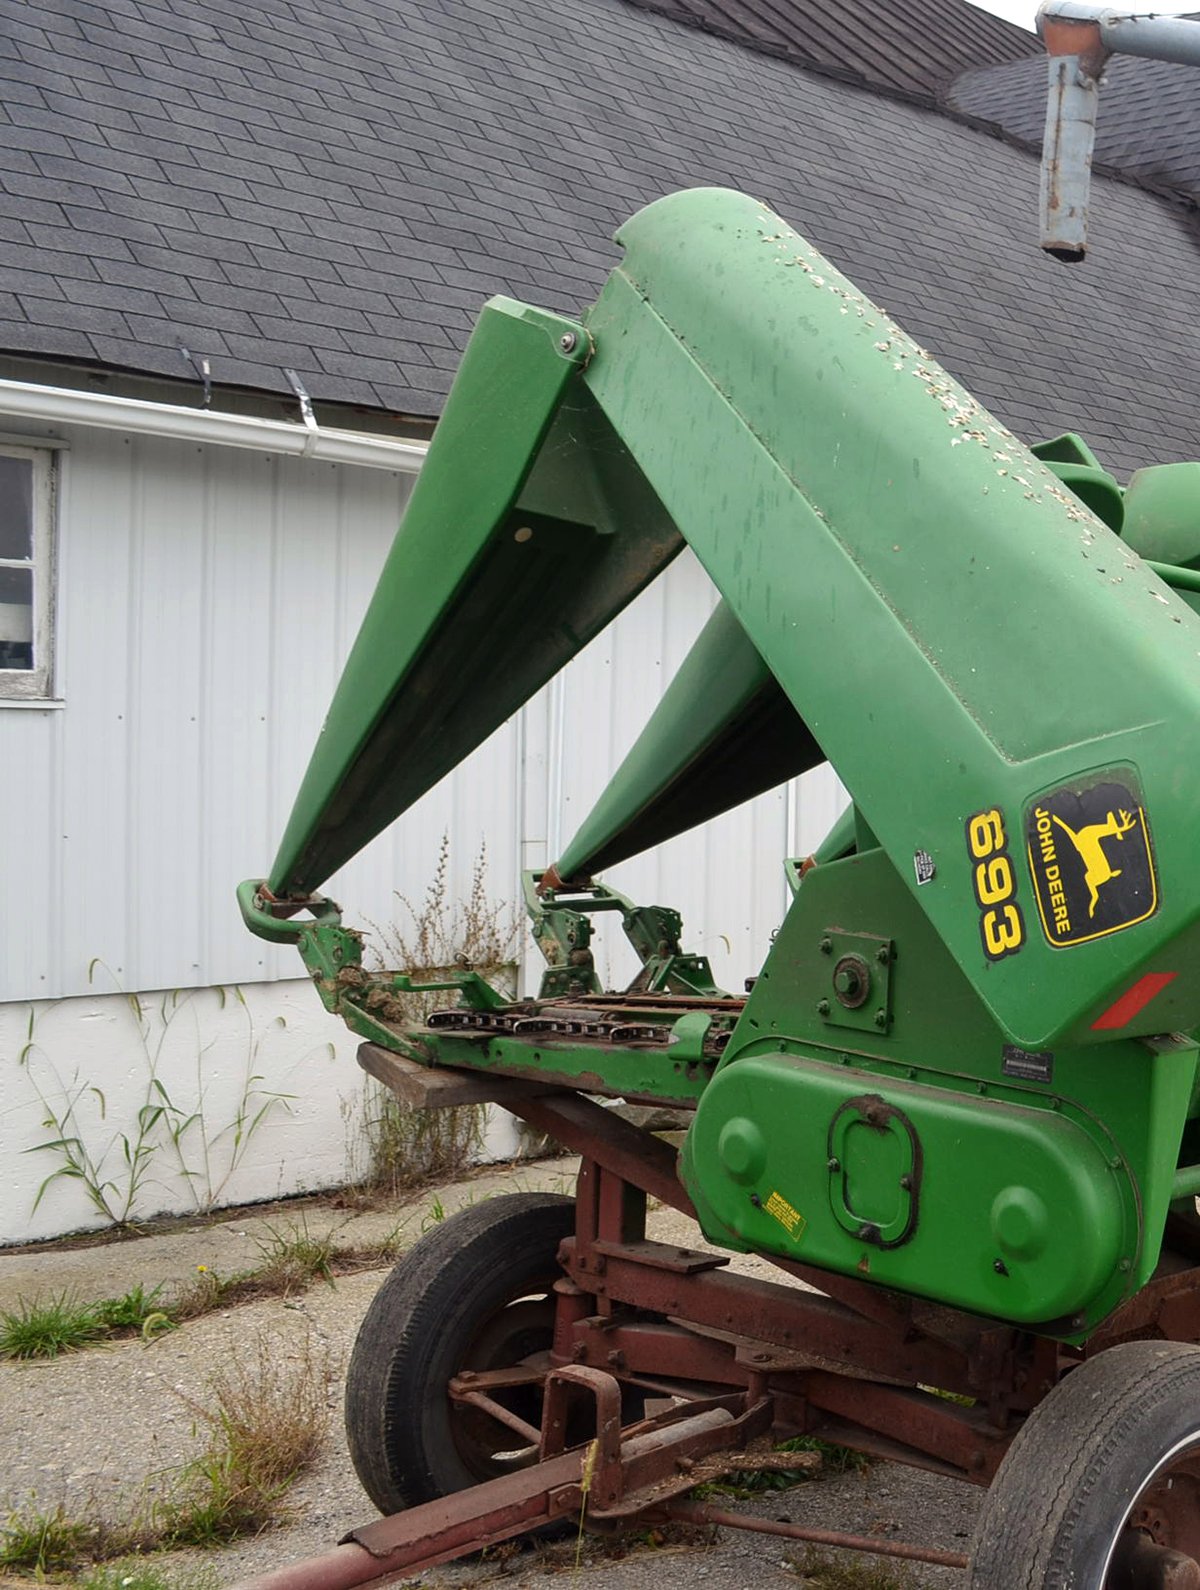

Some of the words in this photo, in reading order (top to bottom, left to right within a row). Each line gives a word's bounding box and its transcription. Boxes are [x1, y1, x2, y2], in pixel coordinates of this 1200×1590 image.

[1034, 807, 1057, 863] JOHN
[968, 808, 1023, 956] 693
[1045, 865, 1071, 935] DEERE
[772, 1191, 802, 1221] IMPORTANT
